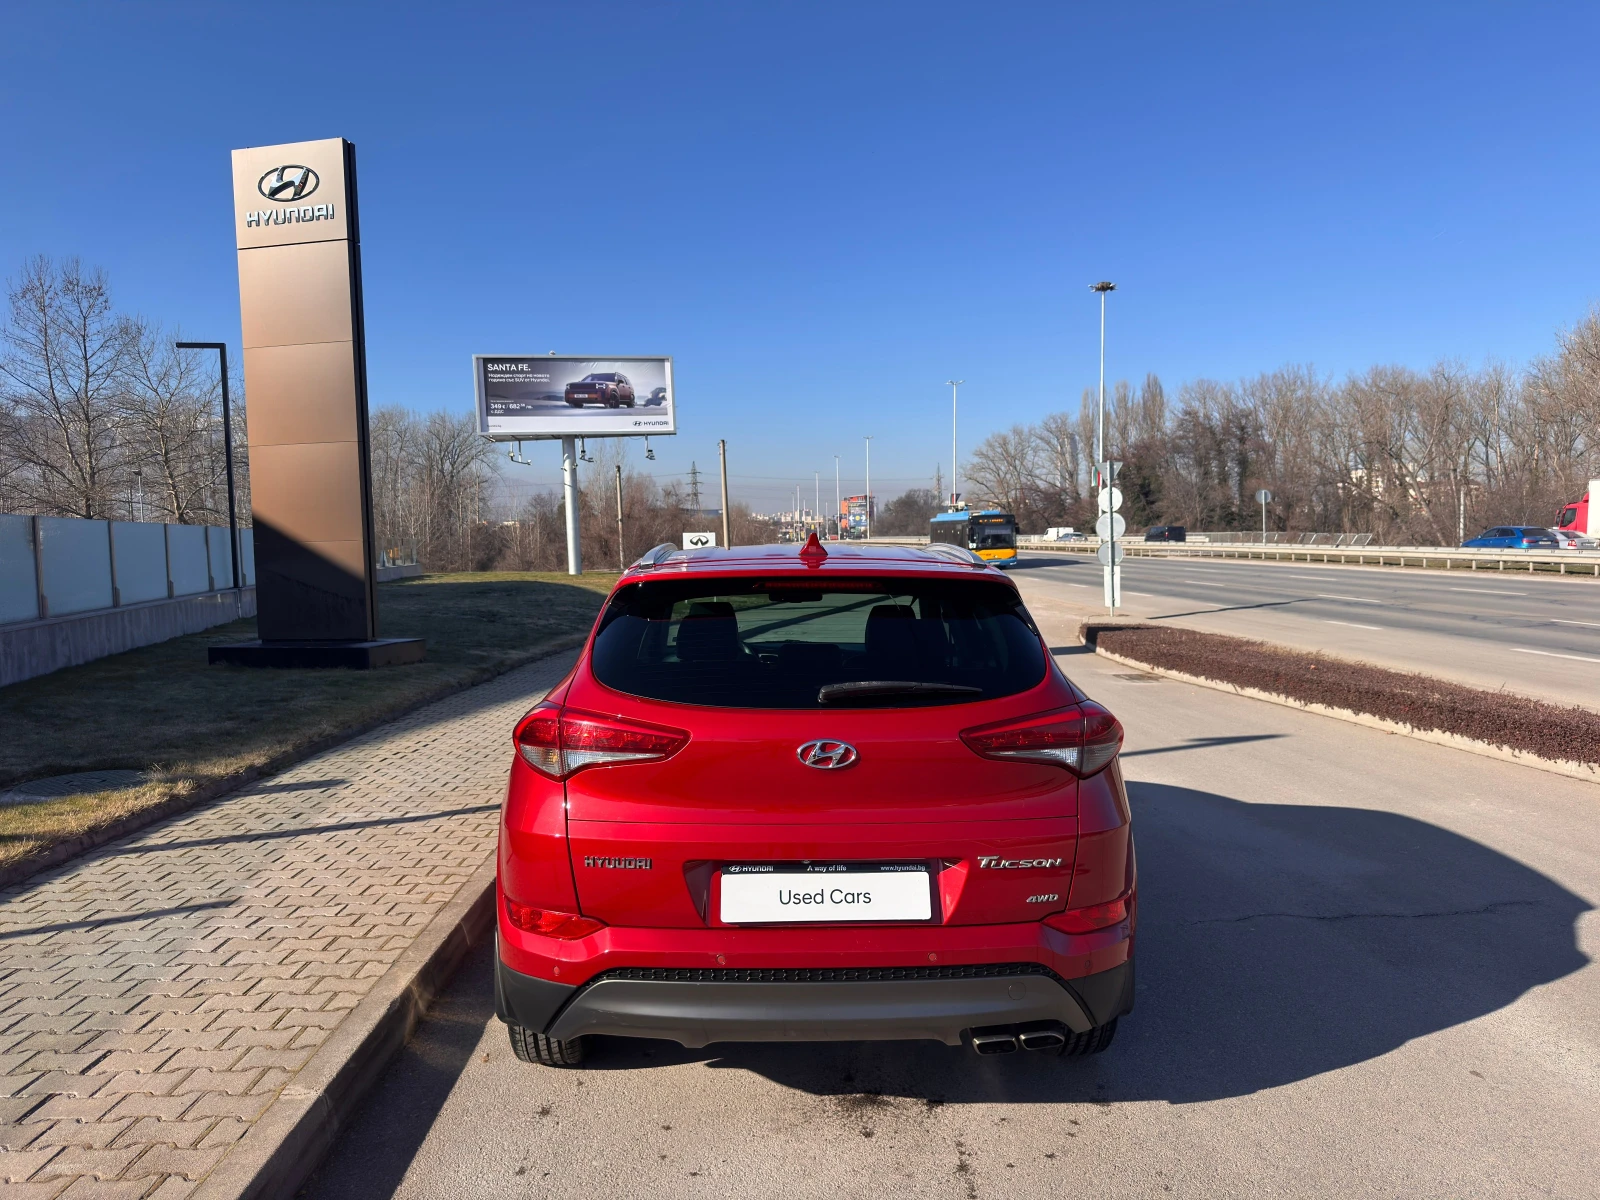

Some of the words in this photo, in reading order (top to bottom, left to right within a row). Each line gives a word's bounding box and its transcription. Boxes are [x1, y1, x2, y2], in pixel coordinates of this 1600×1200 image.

[246, 203, 335, 227] HYUNDAI
[584, 855, 652, 869] HYUNDAI
[779, 889, 824, 905] Used
[829, 888, 872, 905] Cars
[1026, 893, 1059, 903] 4WD
